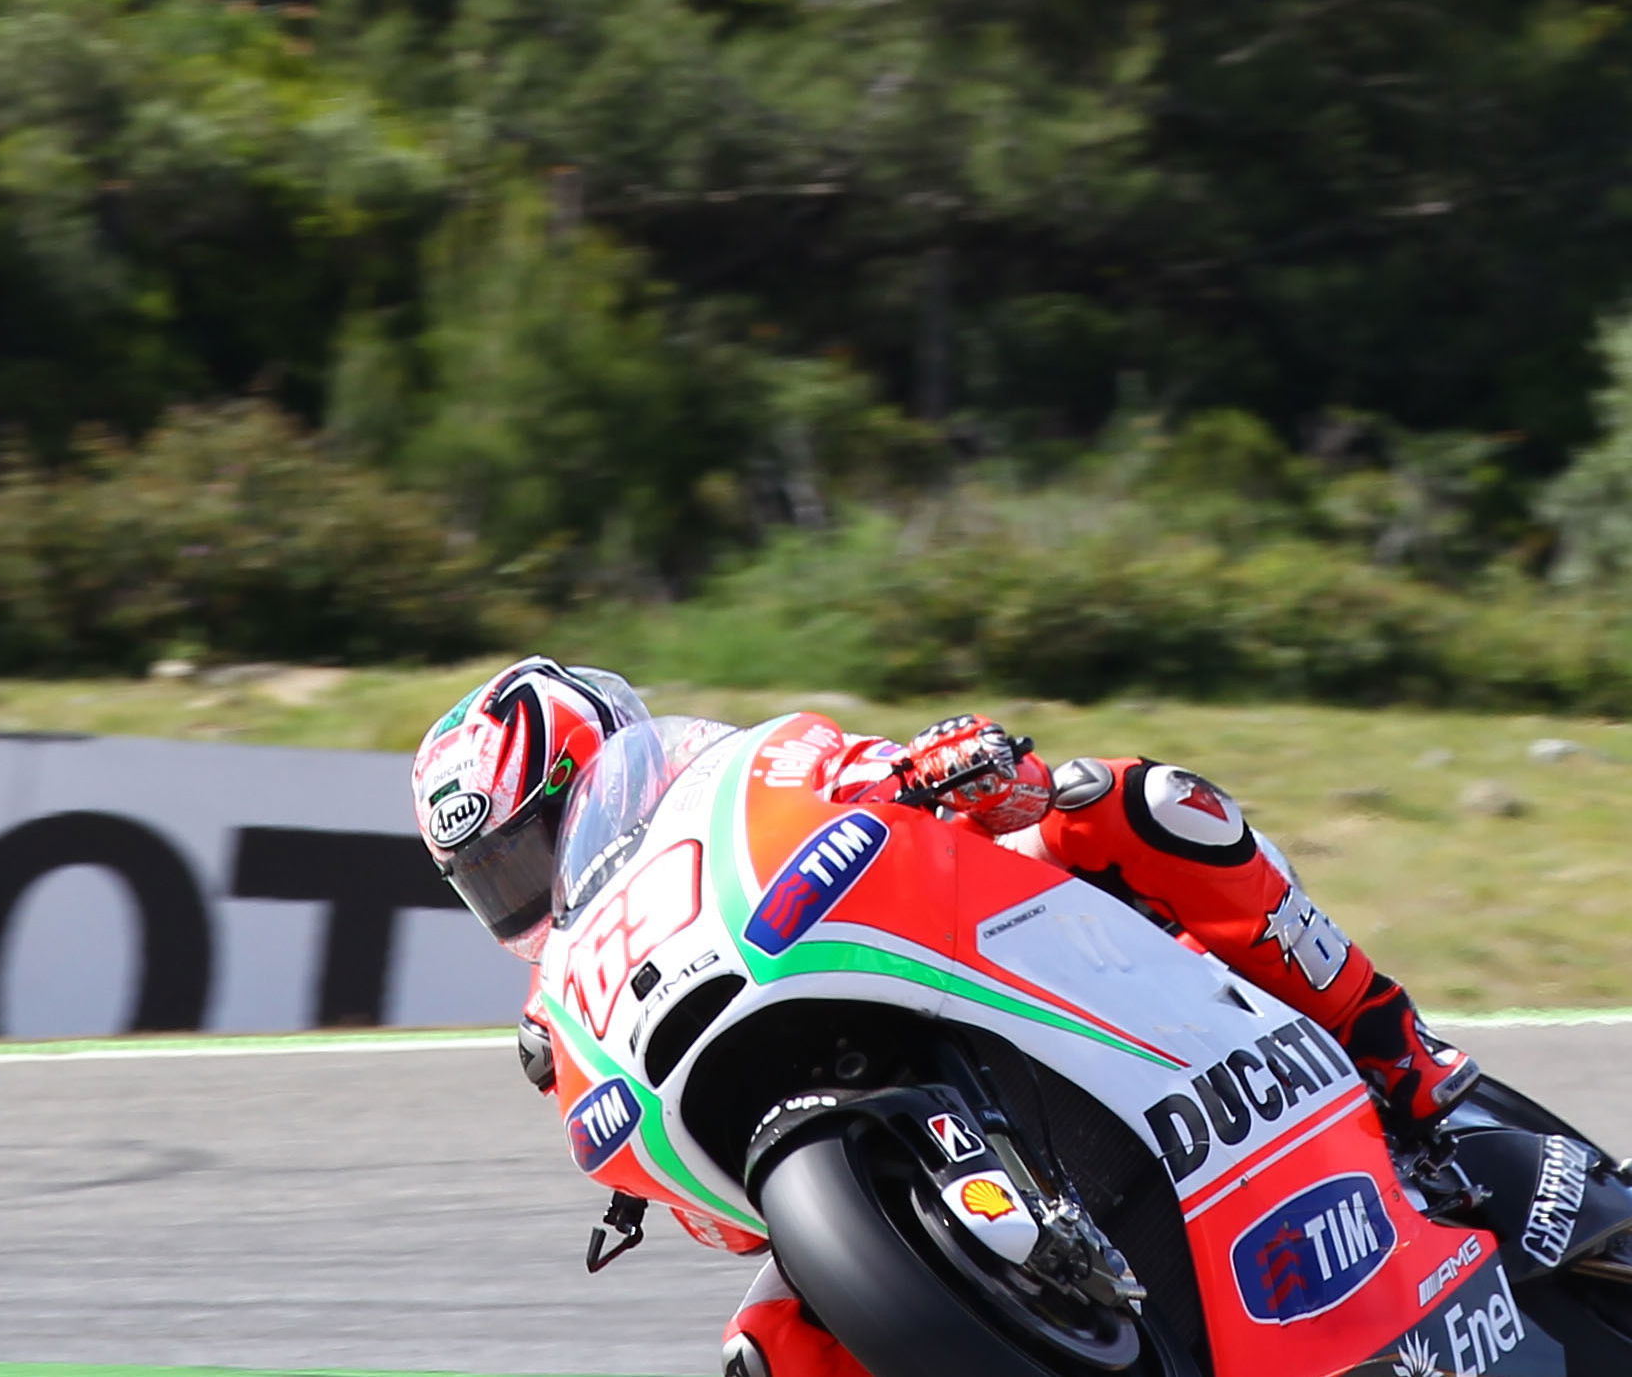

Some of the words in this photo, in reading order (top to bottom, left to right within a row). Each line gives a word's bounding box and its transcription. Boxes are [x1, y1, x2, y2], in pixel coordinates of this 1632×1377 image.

[435, 793, 478, 840] Arai
[799, 820, 874, 887] TIM
[563, 838, 703, 1041] 69
[581, 1086, 630, 1148] TIM
[1143, 1016, 1352, 1183] DUCATI
[1304, 1191, 1379, 1282] TIM
[1434, 1234, 1482, 1292] AMG
[1444, 1264, 1525, 1377] Enel
